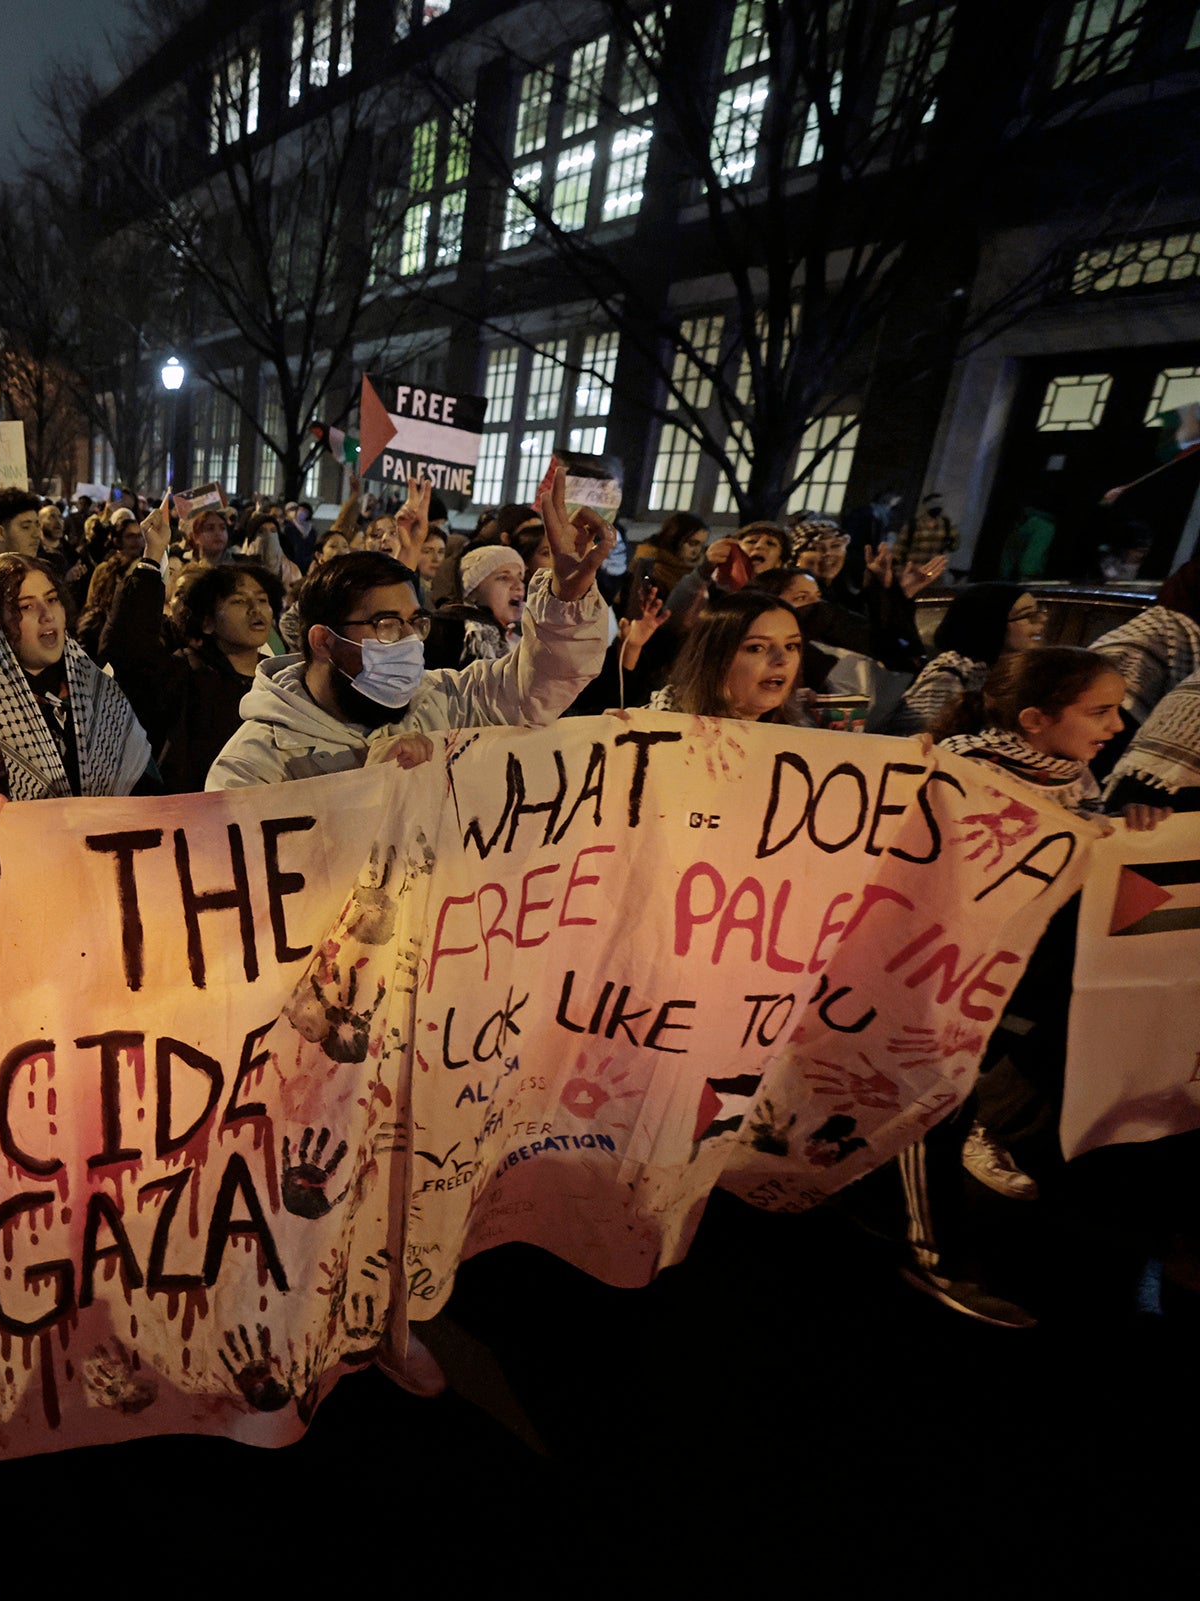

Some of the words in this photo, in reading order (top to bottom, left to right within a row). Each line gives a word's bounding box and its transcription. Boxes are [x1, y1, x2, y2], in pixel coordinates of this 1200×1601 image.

[396, 385, 458, 424] FREE
[381, 454, 475, 496] PALESTINE
[446, 730, 683, 861] WHAT
[754, 751, 967, 865] DOES
[974, 830, 1077, 902] A
[85, 814, 316, 992] THE
[427, 844, 616, 994] FREE
[673, 860, 1022, 1022] PALETINE
[556, 969, 697, 1054] LIKE
[741, 992, 796, 1048] TO
